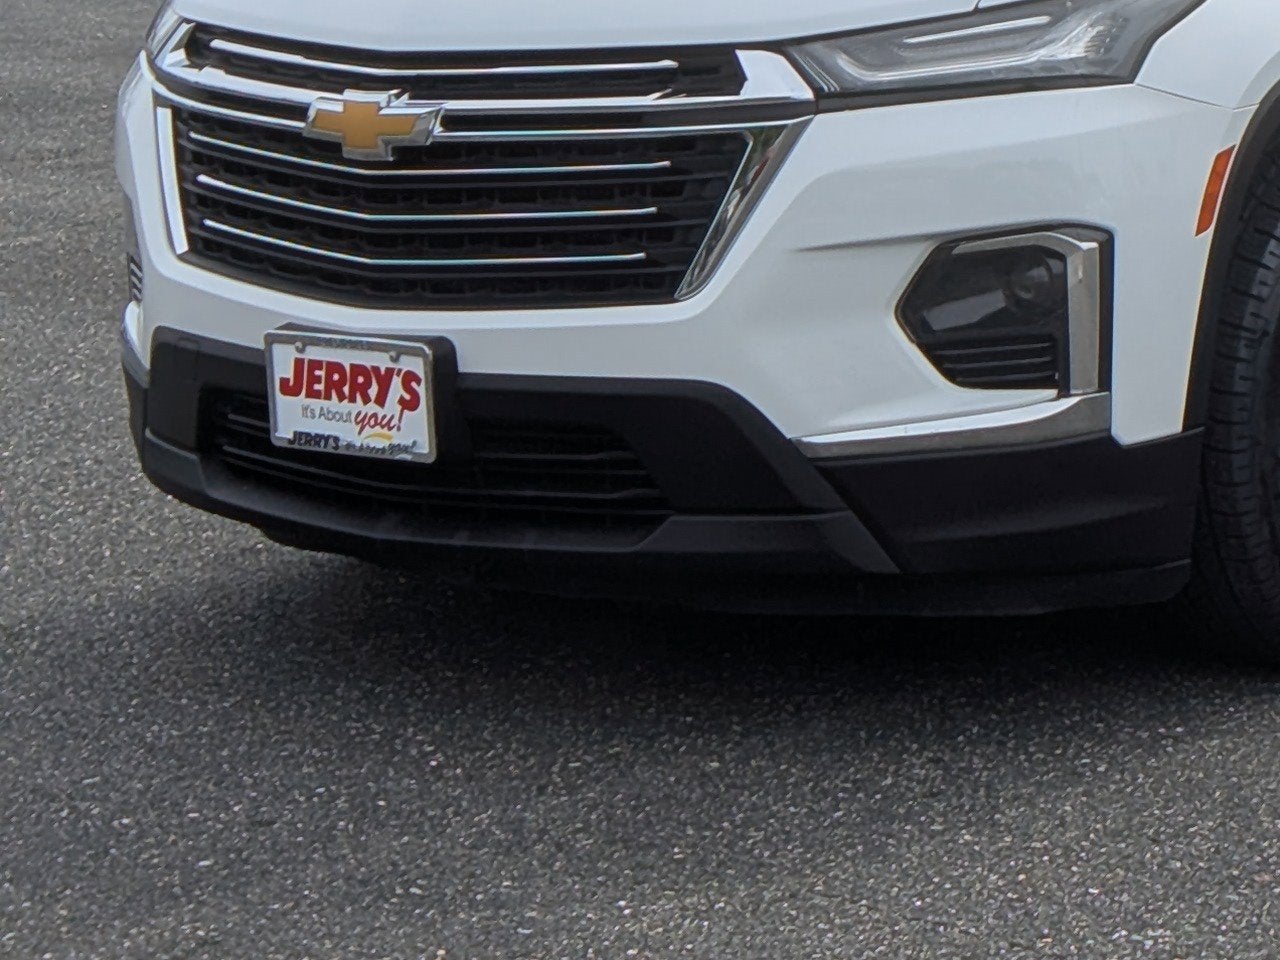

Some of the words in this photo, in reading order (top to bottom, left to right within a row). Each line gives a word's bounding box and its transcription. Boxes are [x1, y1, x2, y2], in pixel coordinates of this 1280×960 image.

[279, 357, 422, 412] JERRY'S
[301, 404, 316, 420] It's
[318, 406, 352, 424] About
[354, 405, 405, 436] you!
